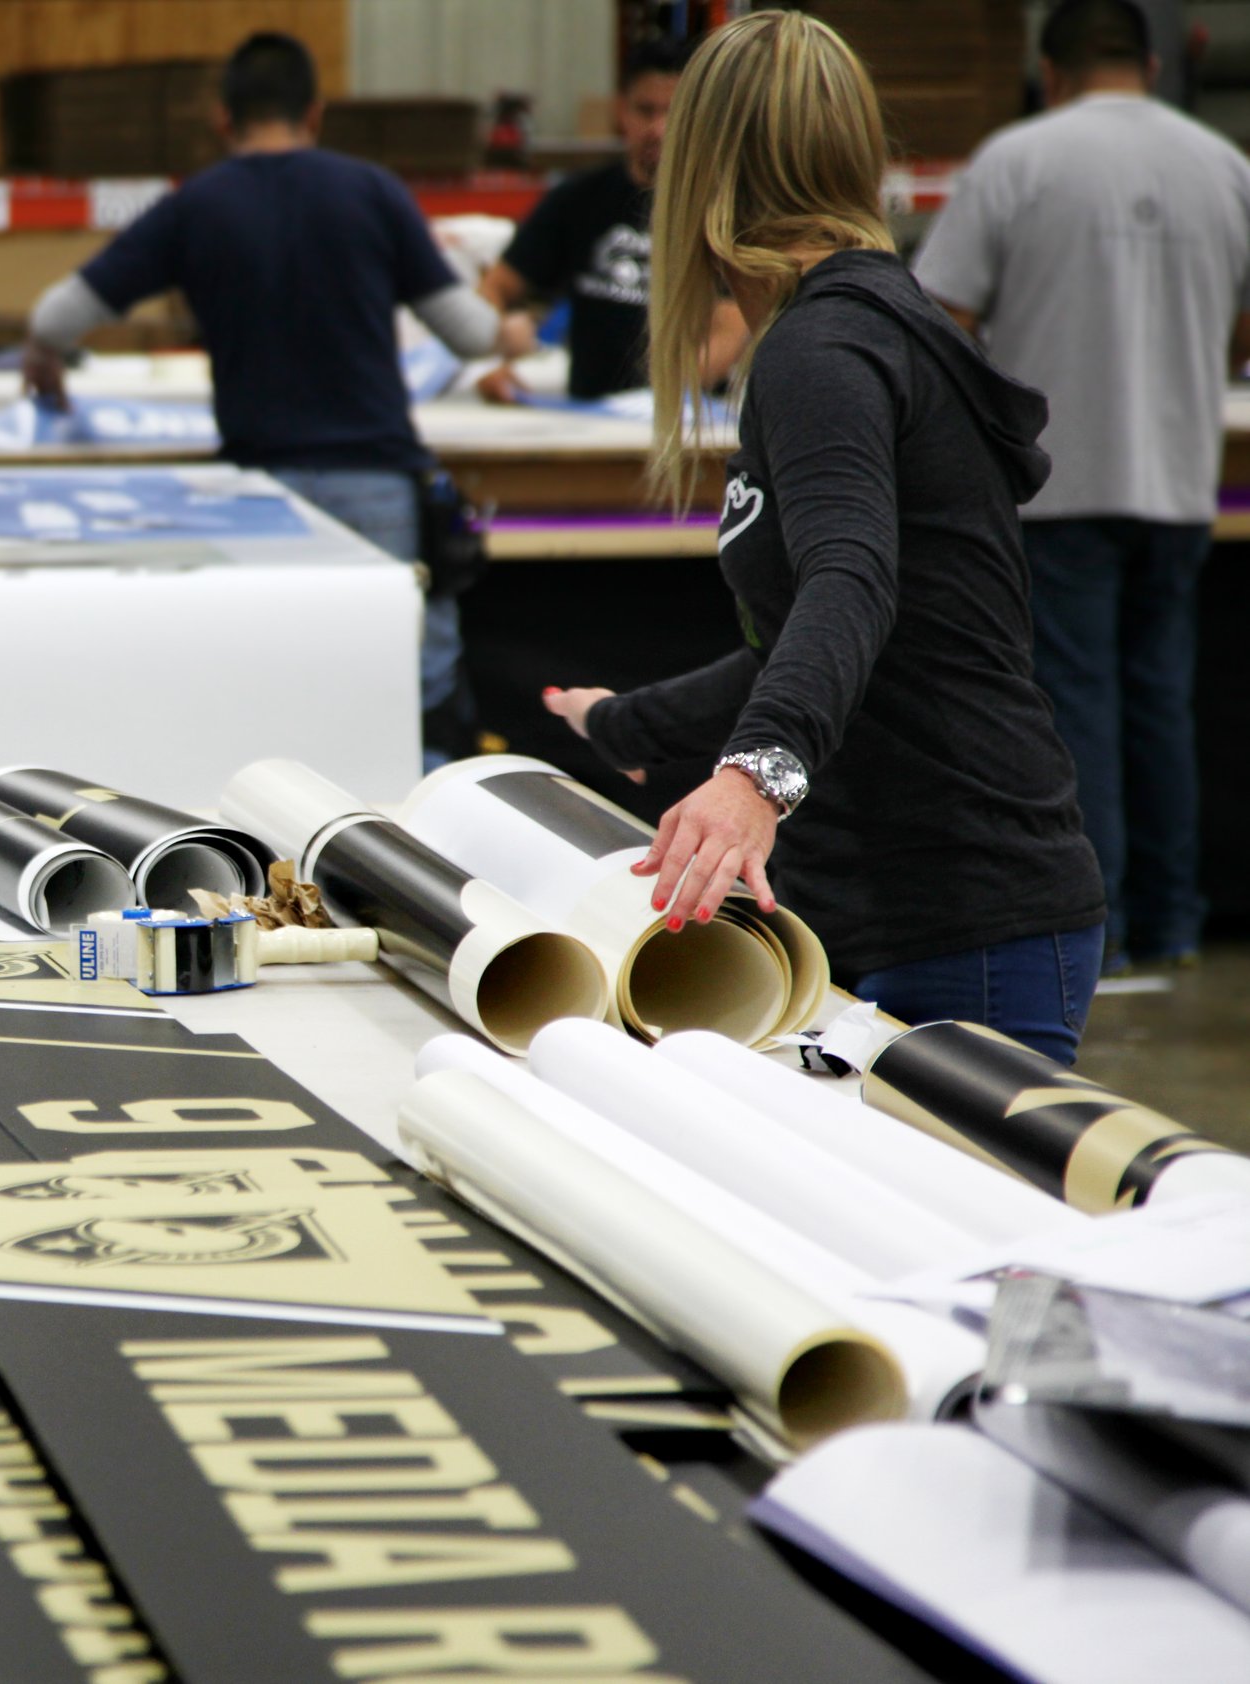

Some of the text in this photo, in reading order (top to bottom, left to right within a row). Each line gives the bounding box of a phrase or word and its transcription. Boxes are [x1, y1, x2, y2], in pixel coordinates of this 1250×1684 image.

[82, 932, 96, 979] ULINE
[119, 1335, 578, 1594] MEDIA
[303, 1605, 692, 1684] R
